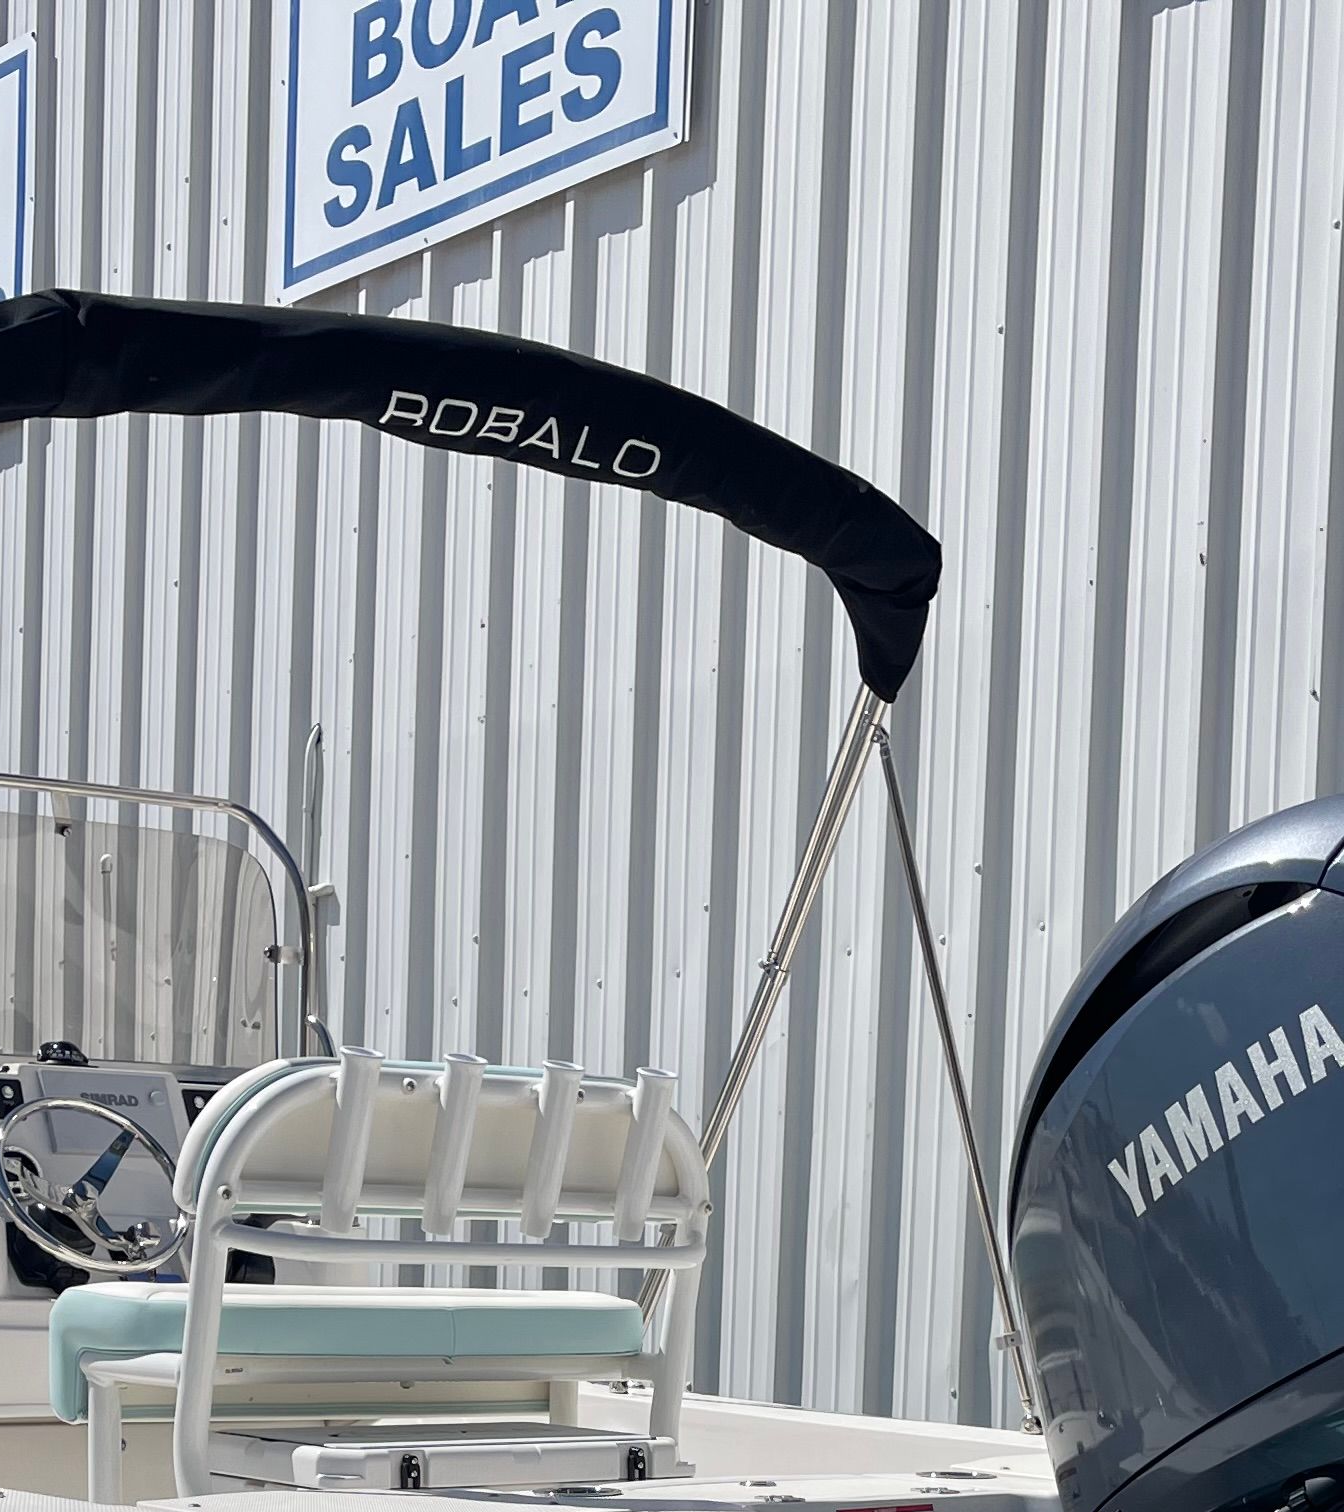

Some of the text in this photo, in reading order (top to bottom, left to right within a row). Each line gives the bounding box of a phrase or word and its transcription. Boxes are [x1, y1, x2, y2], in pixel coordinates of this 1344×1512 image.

[323, 7, 622, 228] SALES
[378, 390, 661, 477] ROBALO
[80, 1092, 139, 1107] SIMRAD
